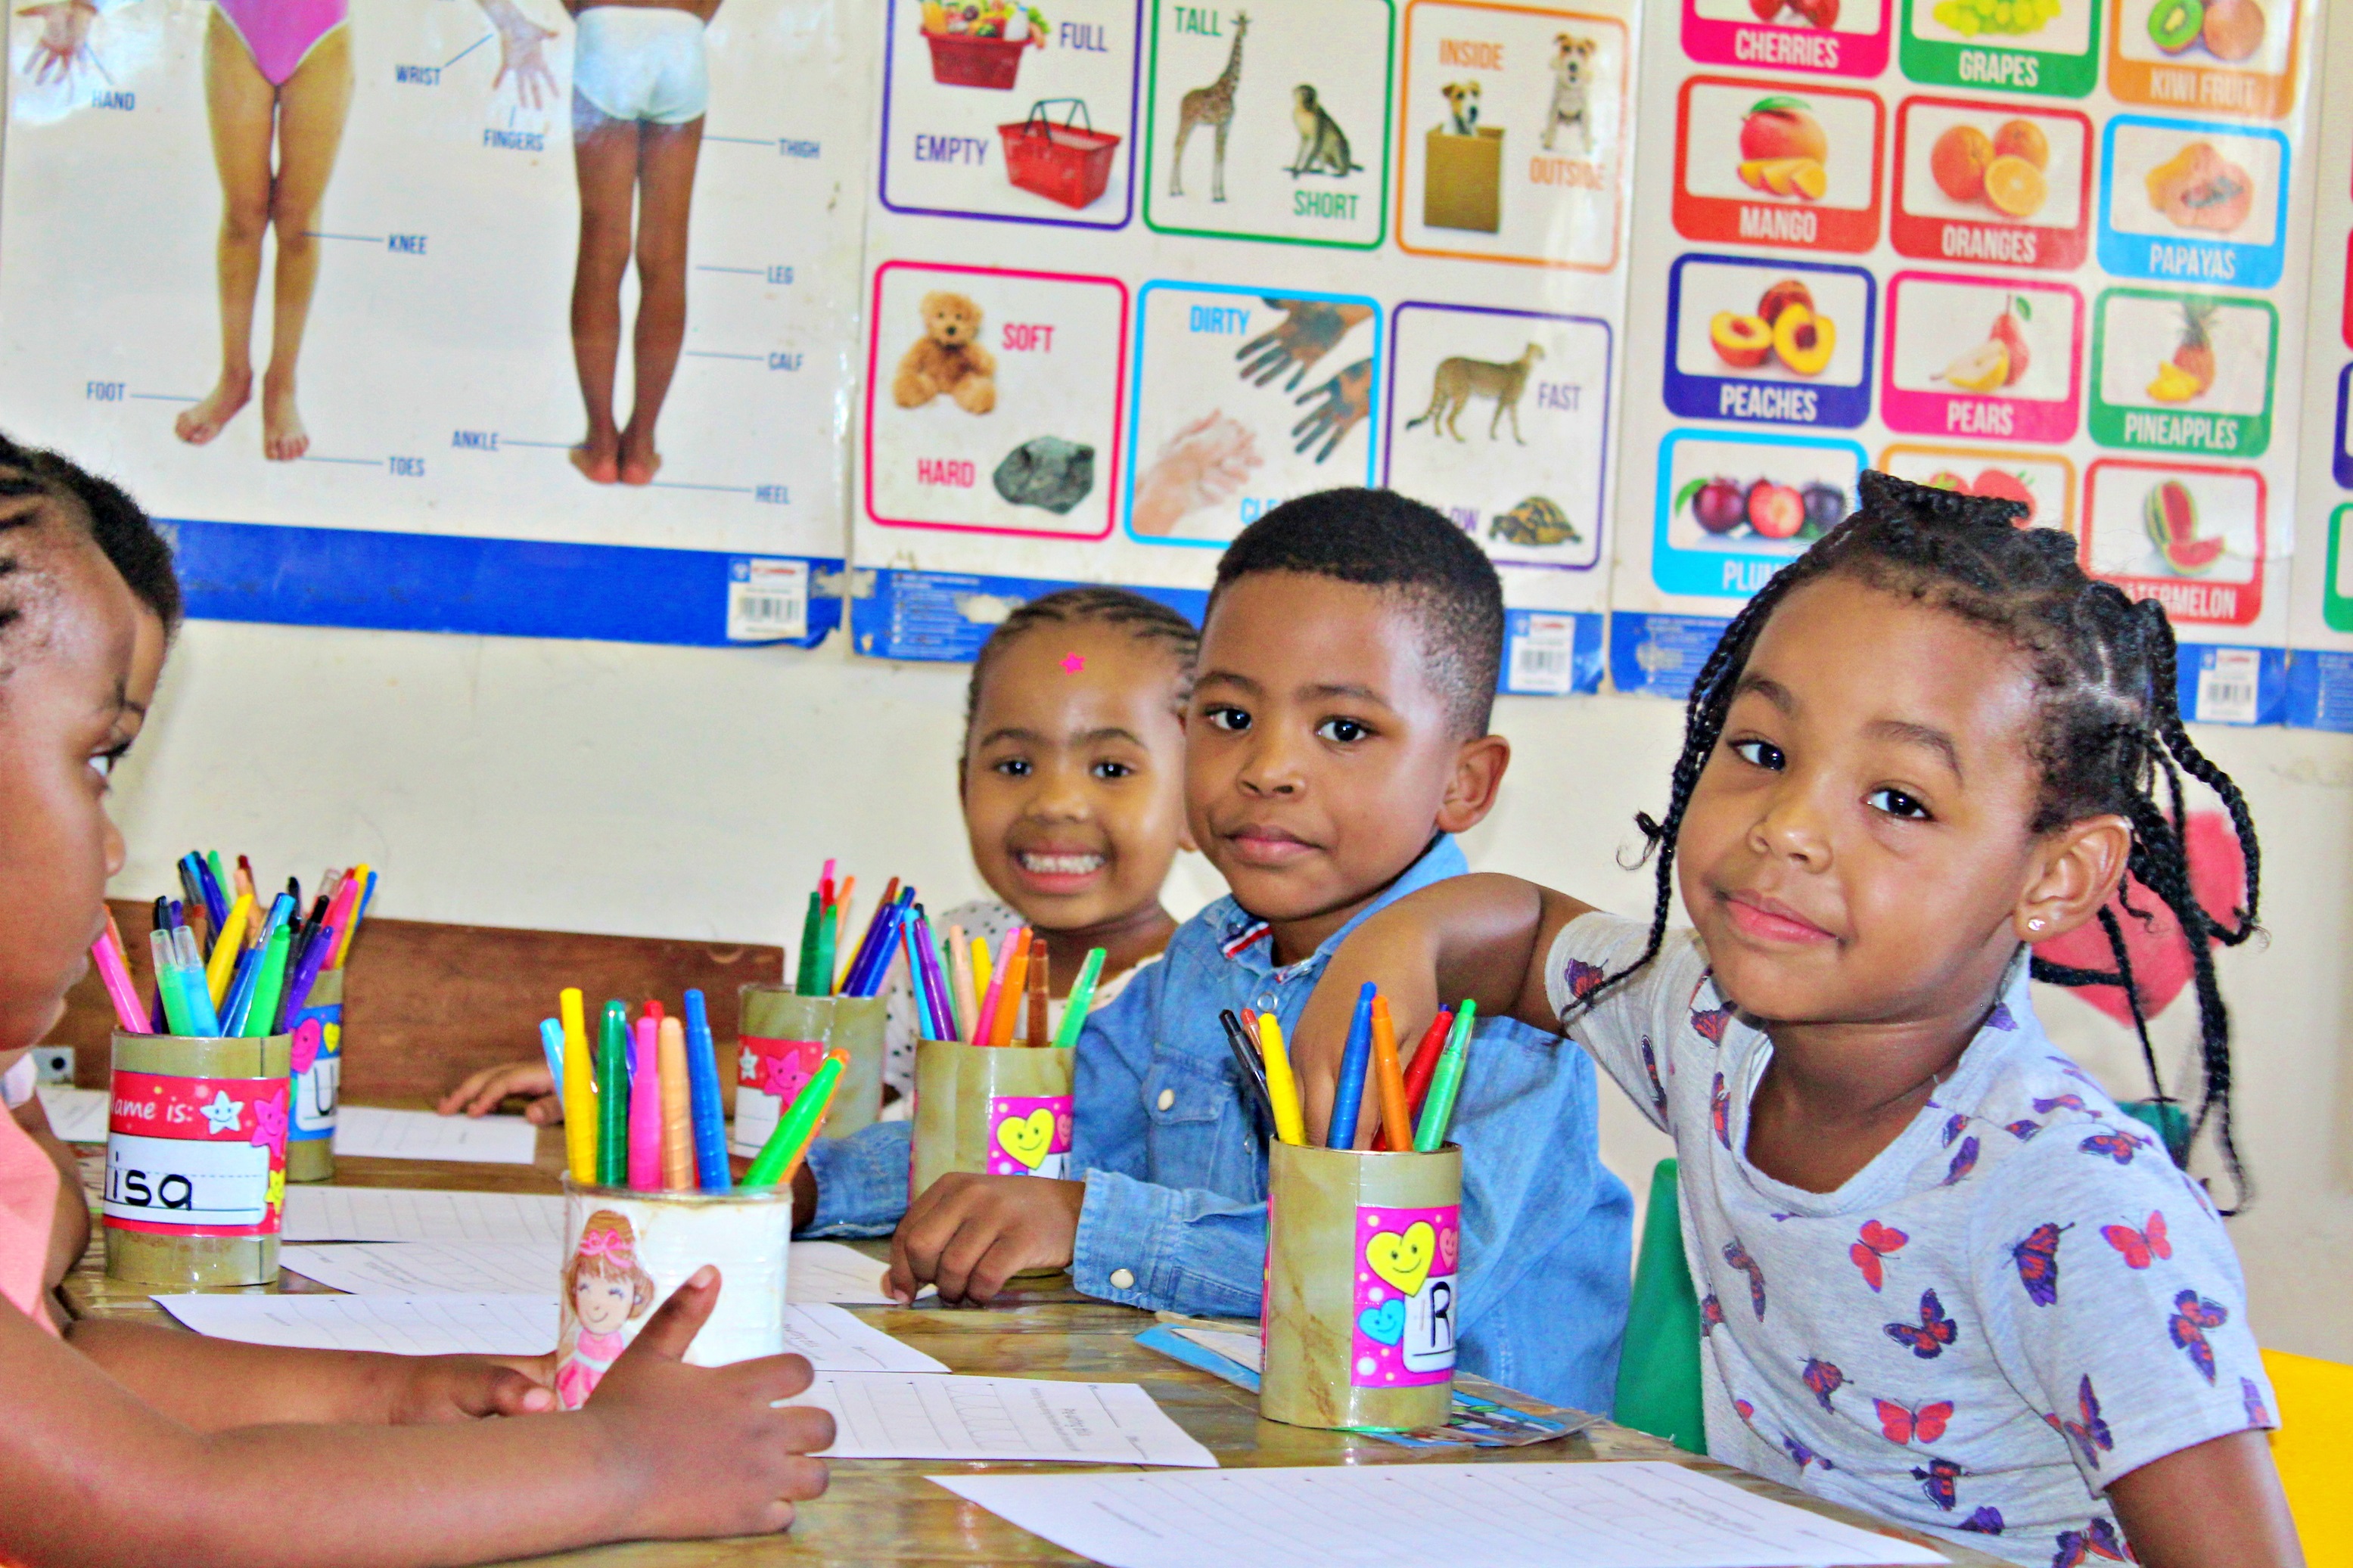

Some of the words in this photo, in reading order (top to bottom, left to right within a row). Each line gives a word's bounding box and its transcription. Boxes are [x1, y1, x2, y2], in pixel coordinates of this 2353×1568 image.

[1175, 6, 1223, 37] TALL
[1059, 22, 1108, 52] FULL
[1735, 29, 1839, 69] CHERRIES
[1439, 39, 1505, 71] INSIDE
[1959, 51, 2039, 87] GRAPES
[396, 65, 443, 86] WRIST
[2150, 67, 2197, 101] KIWI
[2200, 74, 2256, 107] FRUIT
[92, 89, 135, 112] HAND
[483, 129, 545, 152] FINGERS
[779, 138, 821, 159] THIGH
[915, 135, 990, 166] EMPTY
[1528, 156, 1605, 191] OUTSIDE
[1293, 190, 1360, 220] SHORT
[1739, 206, 1817, 243] MANGO
[388, 233, 428, 255] KNEE
[1942, 225, 2038, 264] ORANGES
[767, 265, 794, 285] LEG
[2149, 244, 2236, 280] PAPAYAS
[1190, 305, 1251, 336] DIRTY
[1002, 323, 1055, 353] SOFT
[767, 352, 804, 373] CALF
[86, 381, 126, 402] FOOT
[1537, 382, 1582, 411] FAST
[1720, 383, 1818, 421] PEACHES
[1947, 400, 2015, 435] PEARS
[2124, 412, 2239, 450] PINEAPPLES
[451, 430, 499, 451] ANKLE
[389, 456, 425, 477] TOES
[918, 458, 976, 489] HARD
[756, 484, 791, 505] HEEL
[166, 1096, 194, 1124] is:
